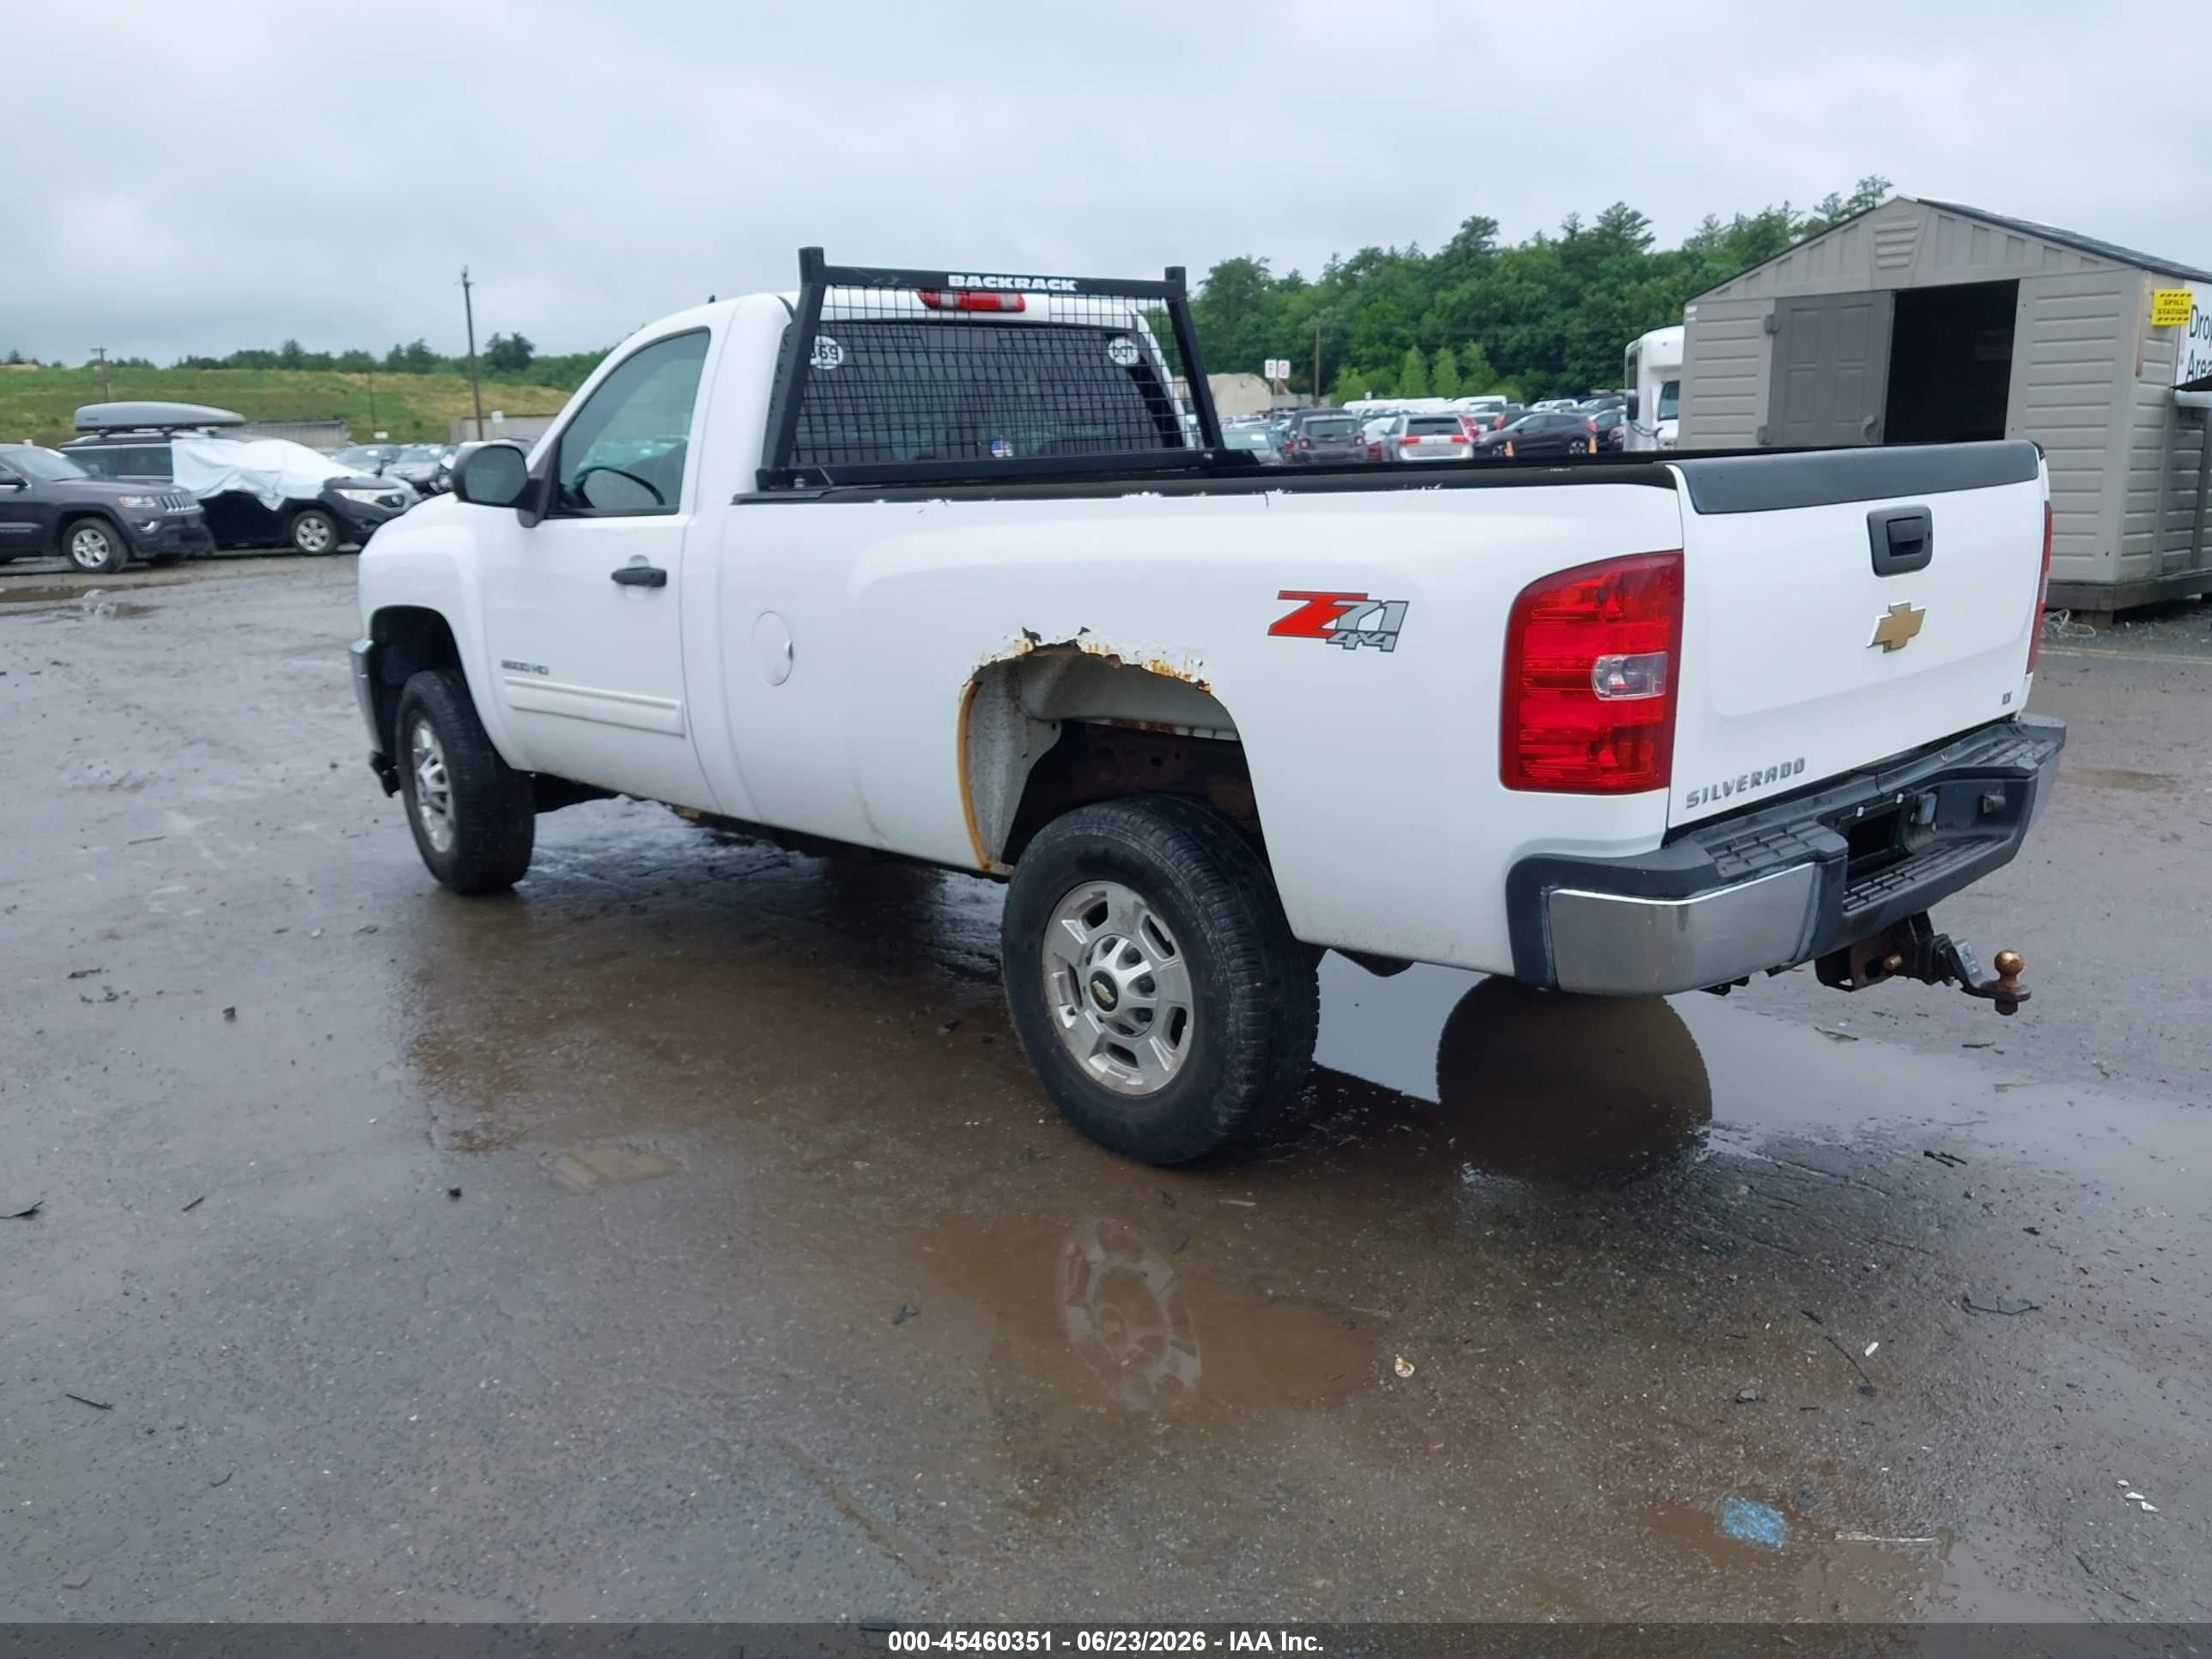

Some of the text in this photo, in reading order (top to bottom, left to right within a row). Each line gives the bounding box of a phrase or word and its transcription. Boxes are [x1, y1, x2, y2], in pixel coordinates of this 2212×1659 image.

[948, 274, 1079, 291] BACKRACK
[1267, 590, 1410, 639] Z71
[1686, 757, 1806, 810] SILVERADO
